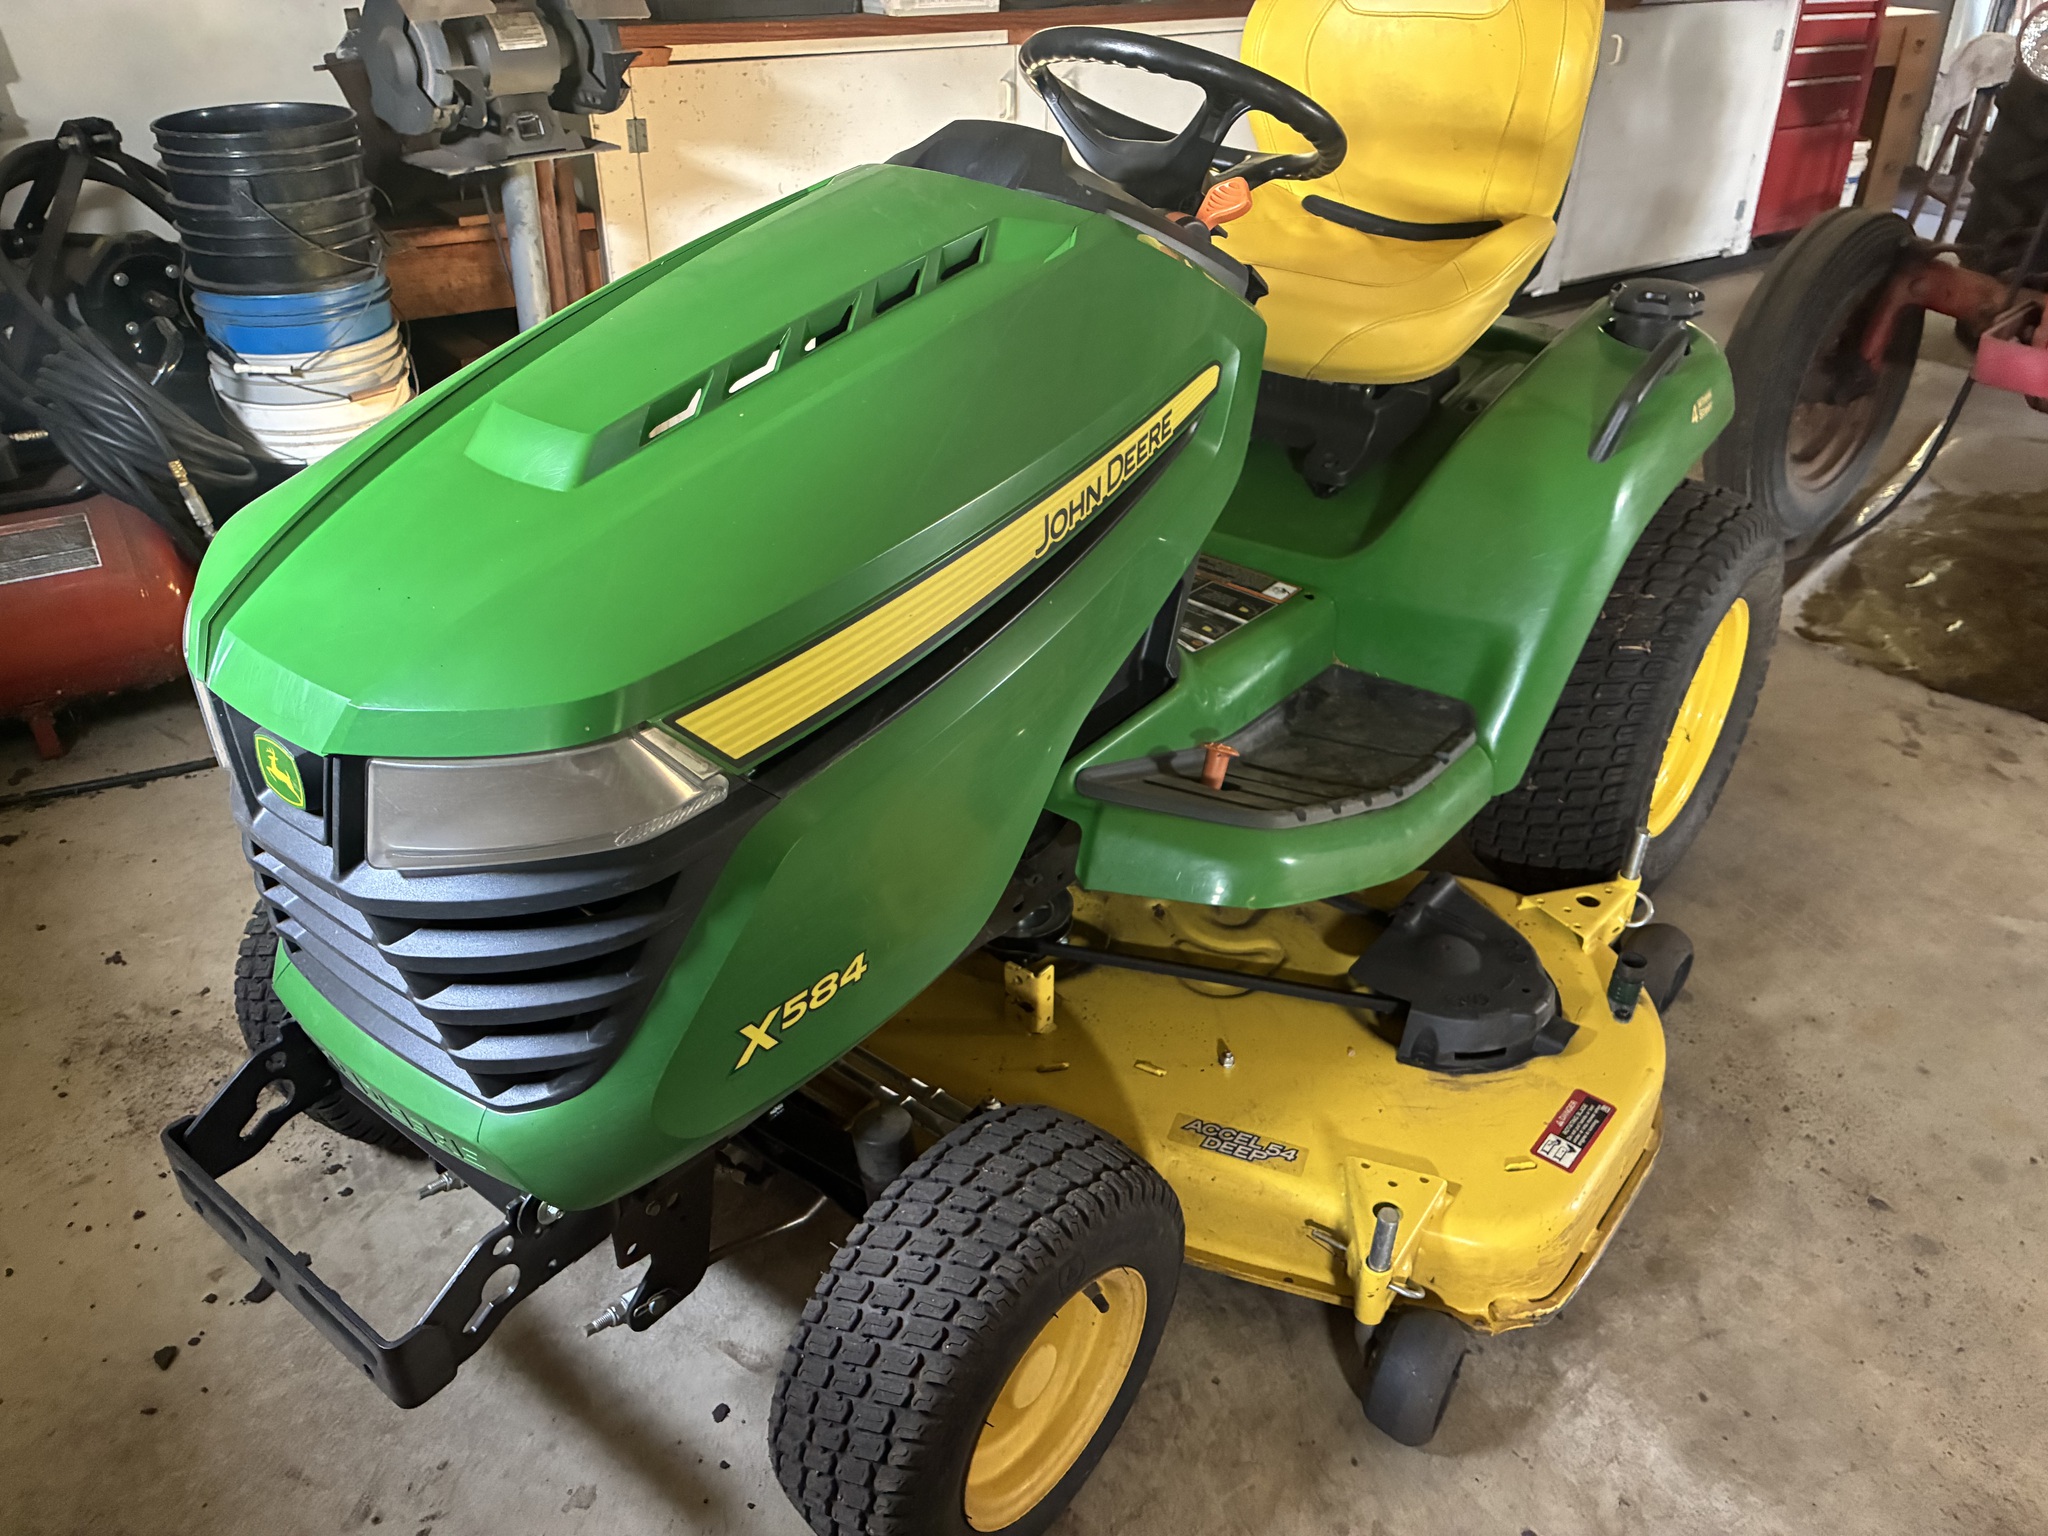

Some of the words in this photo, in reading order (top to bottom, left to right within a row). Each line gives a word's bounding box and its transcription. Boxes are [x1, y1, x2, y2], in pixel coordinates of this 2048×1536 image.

[1036, 476, 1102, 557] JOHN
[1107, 409, 1173, 492] DEERE
[734, 950, 868, 1071] X584
[1180, 1119, 1262, 1151] ACCEL
[1265, 1142, 1299, 1162] 54
[1199, 1136, 1270, 1162] DEEP
